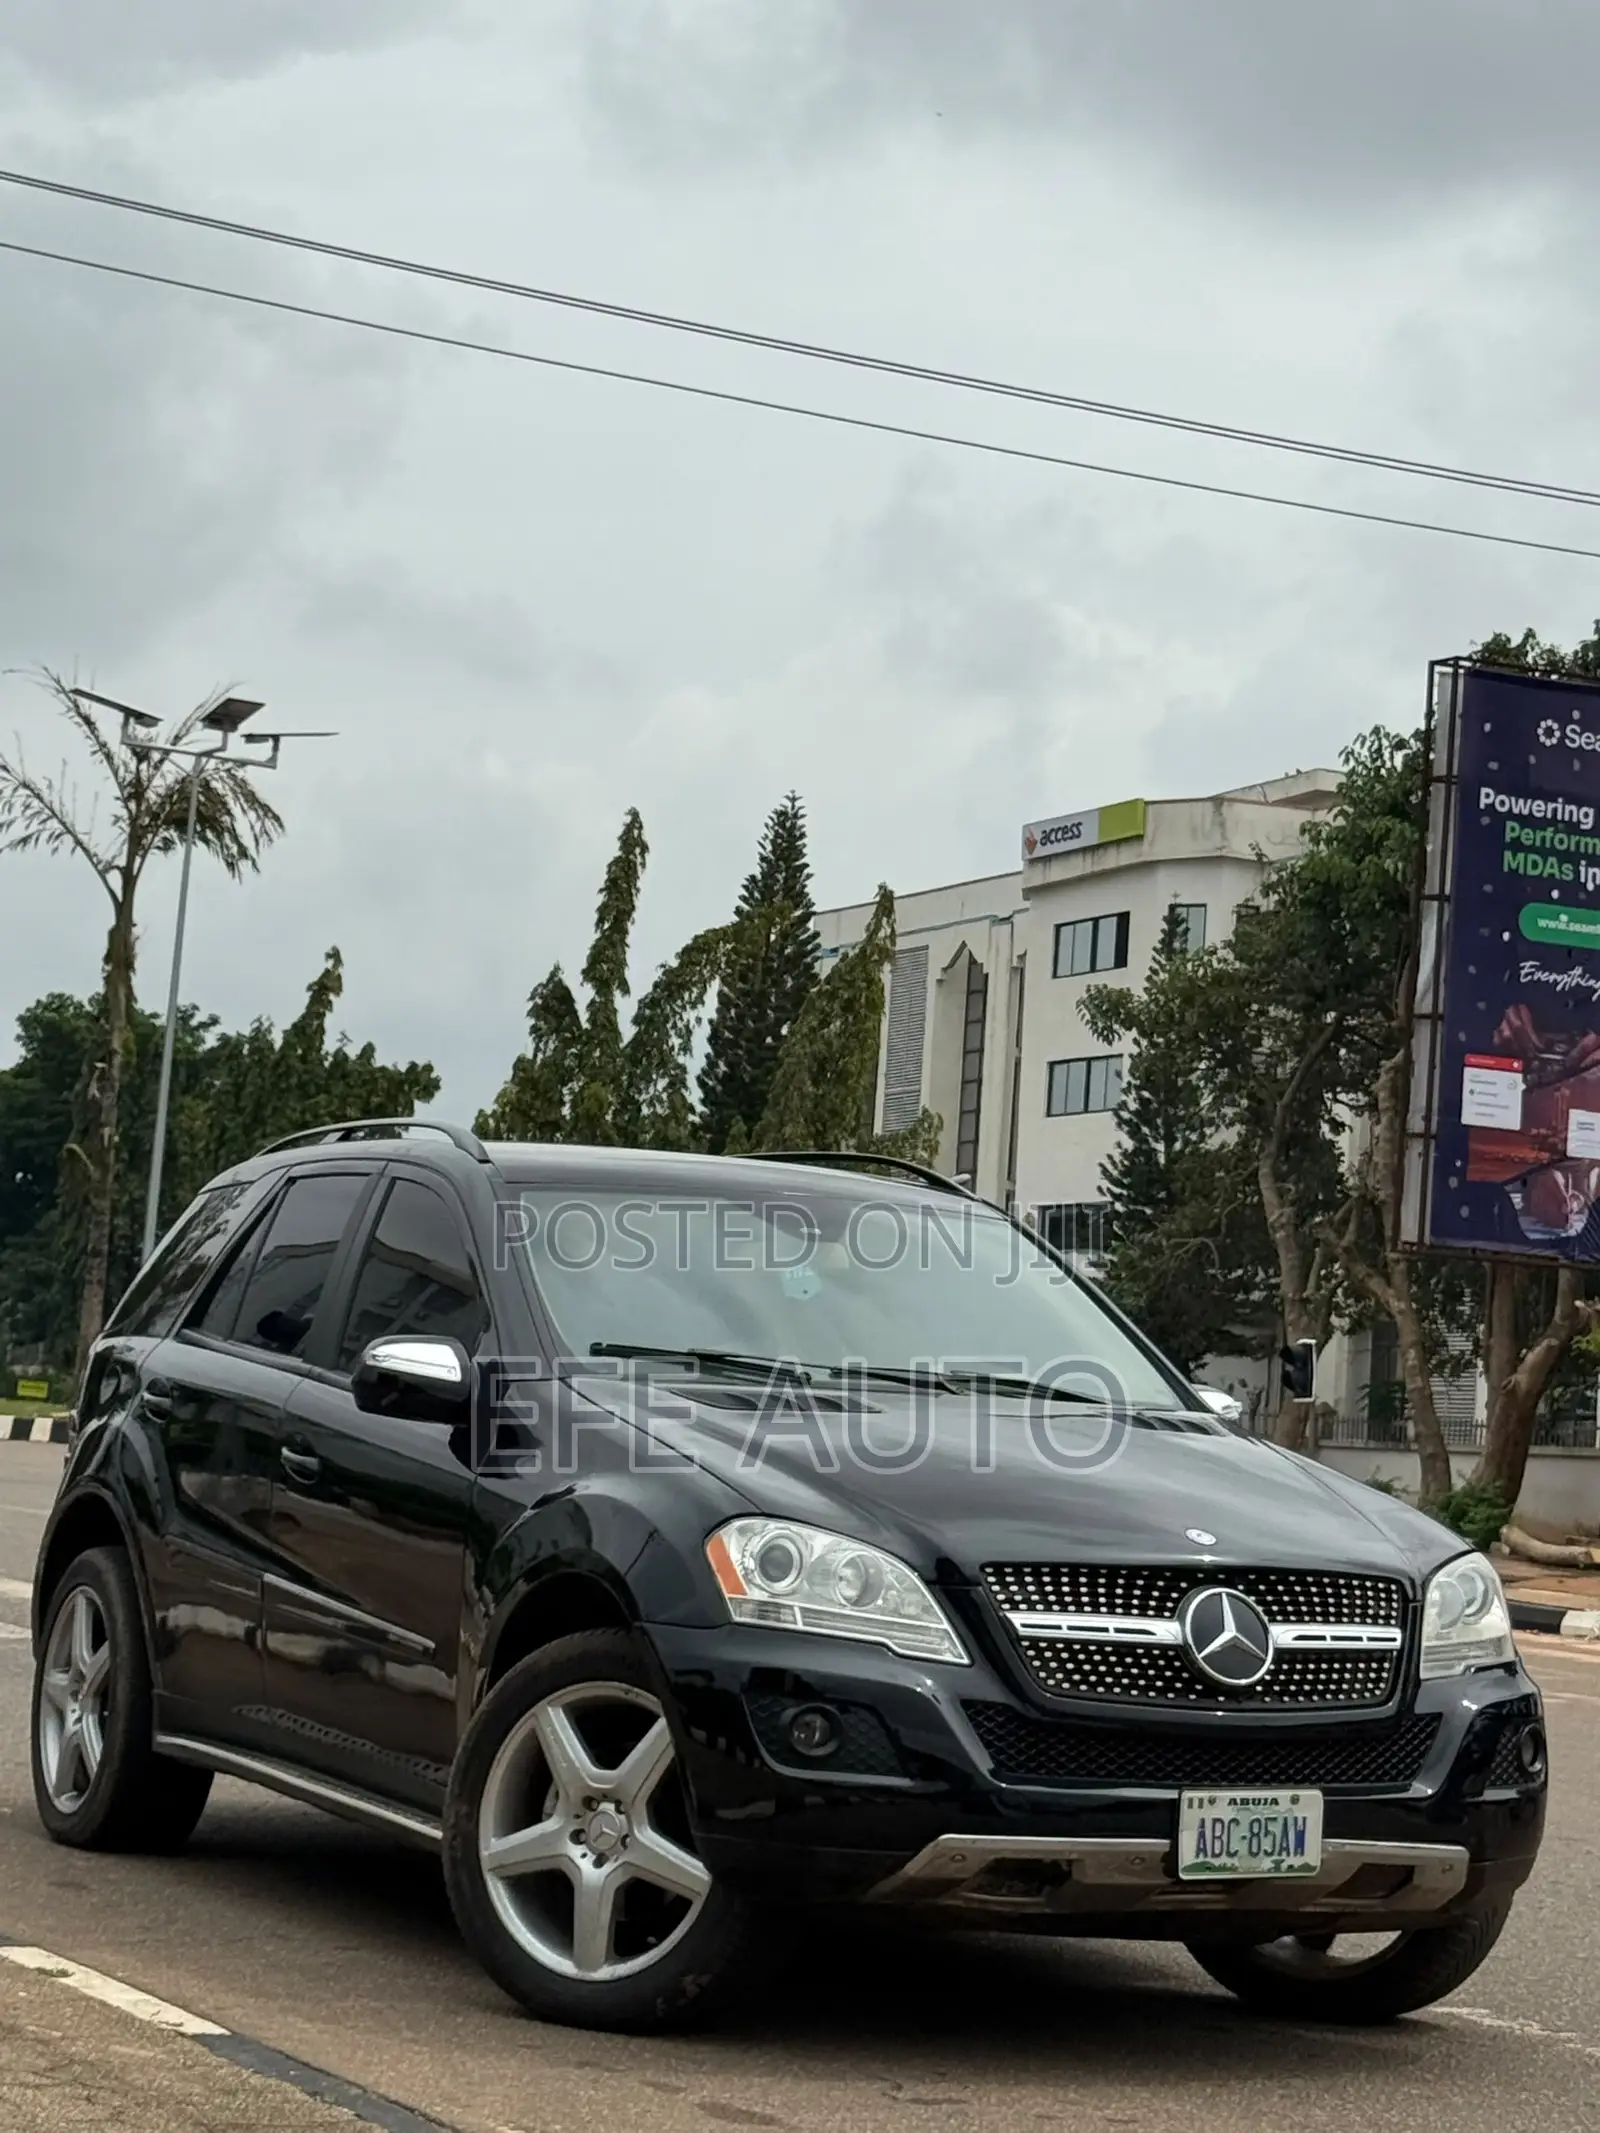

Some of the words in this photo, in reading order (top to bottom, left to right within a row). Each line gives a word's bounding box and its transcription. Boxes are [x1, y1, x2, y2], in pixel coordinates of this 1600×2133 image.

[1479, 786, 1595, 830] Powering
[1039, 821, 1083, 847] access
[1504, 820, 1600, 857] Perform
[1502, 850, 1574, 880] MDAs
[1227, 1796, 1280, 1807] ABUJA
